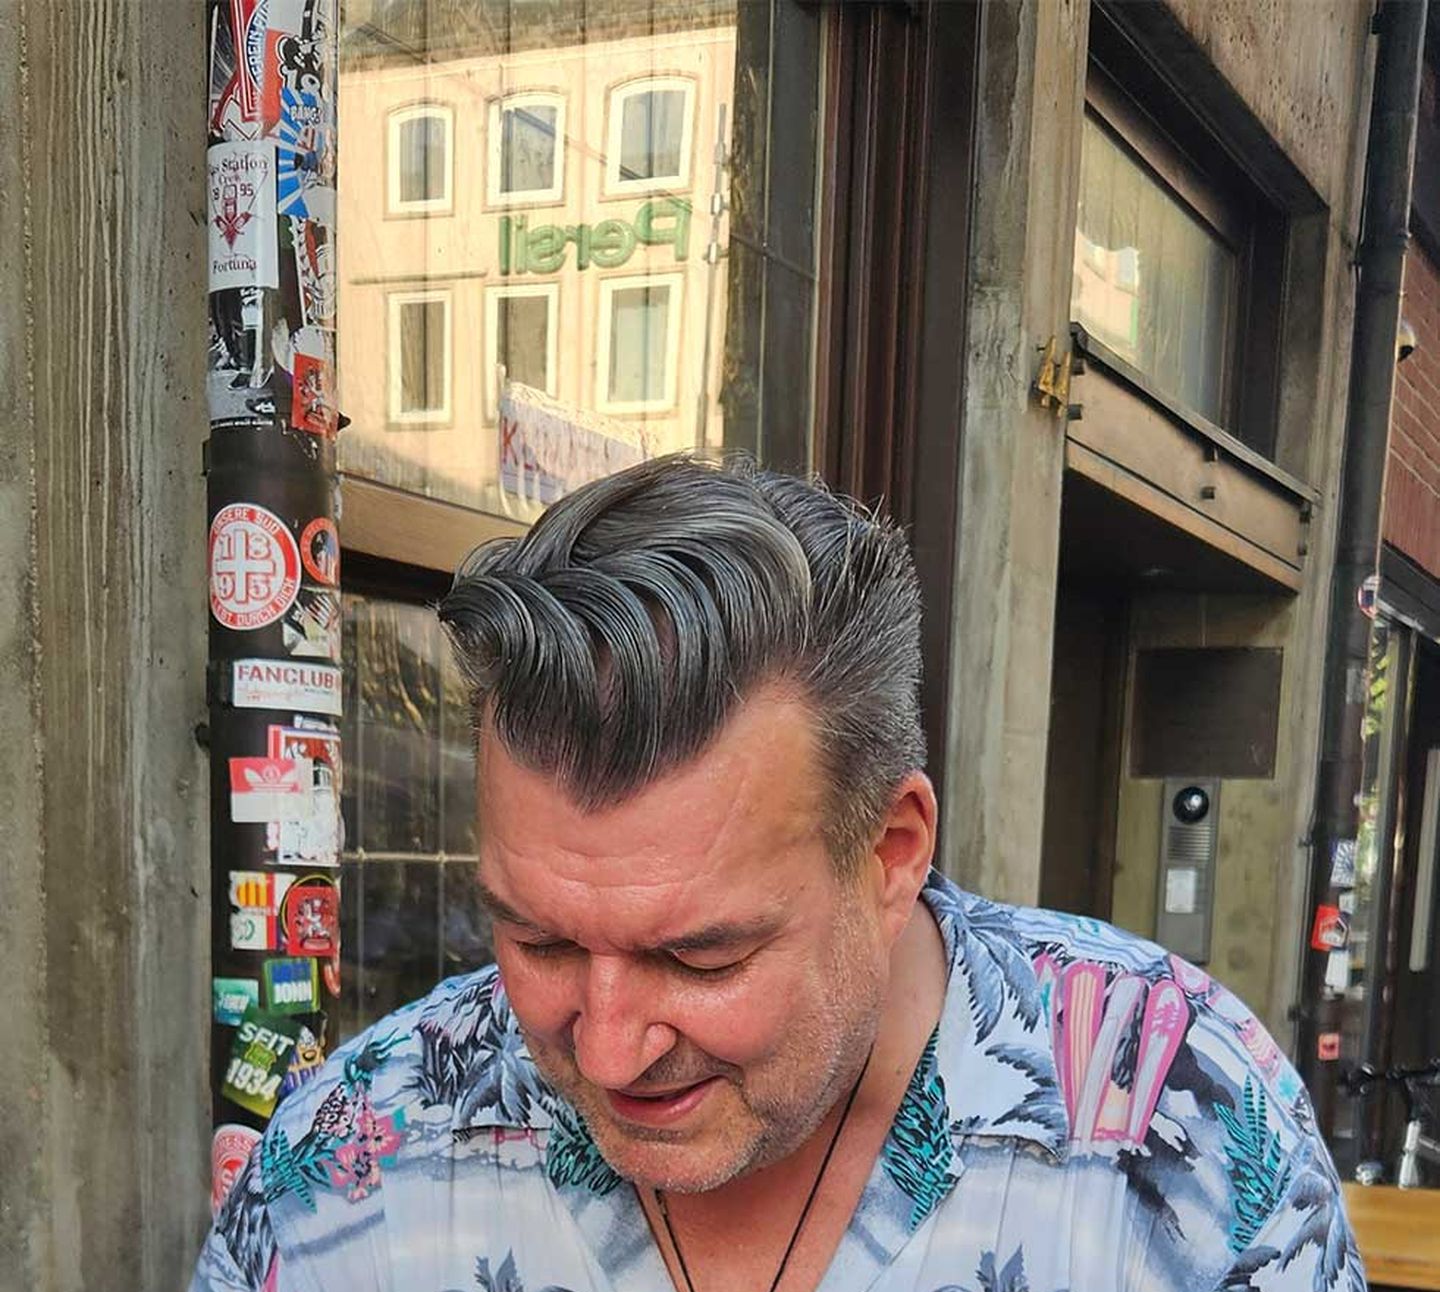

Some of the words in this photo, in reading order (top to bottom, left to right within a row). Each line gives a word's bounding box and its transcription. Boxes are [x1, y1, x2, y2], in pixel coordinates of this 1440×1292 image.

[212, 258, 257, 275] Fortuna
[238, 665, 334, 689] FANCLUB
[239, 1021, 295, 1057] SEIT
[226, 1058, 282, 1101] 1934
